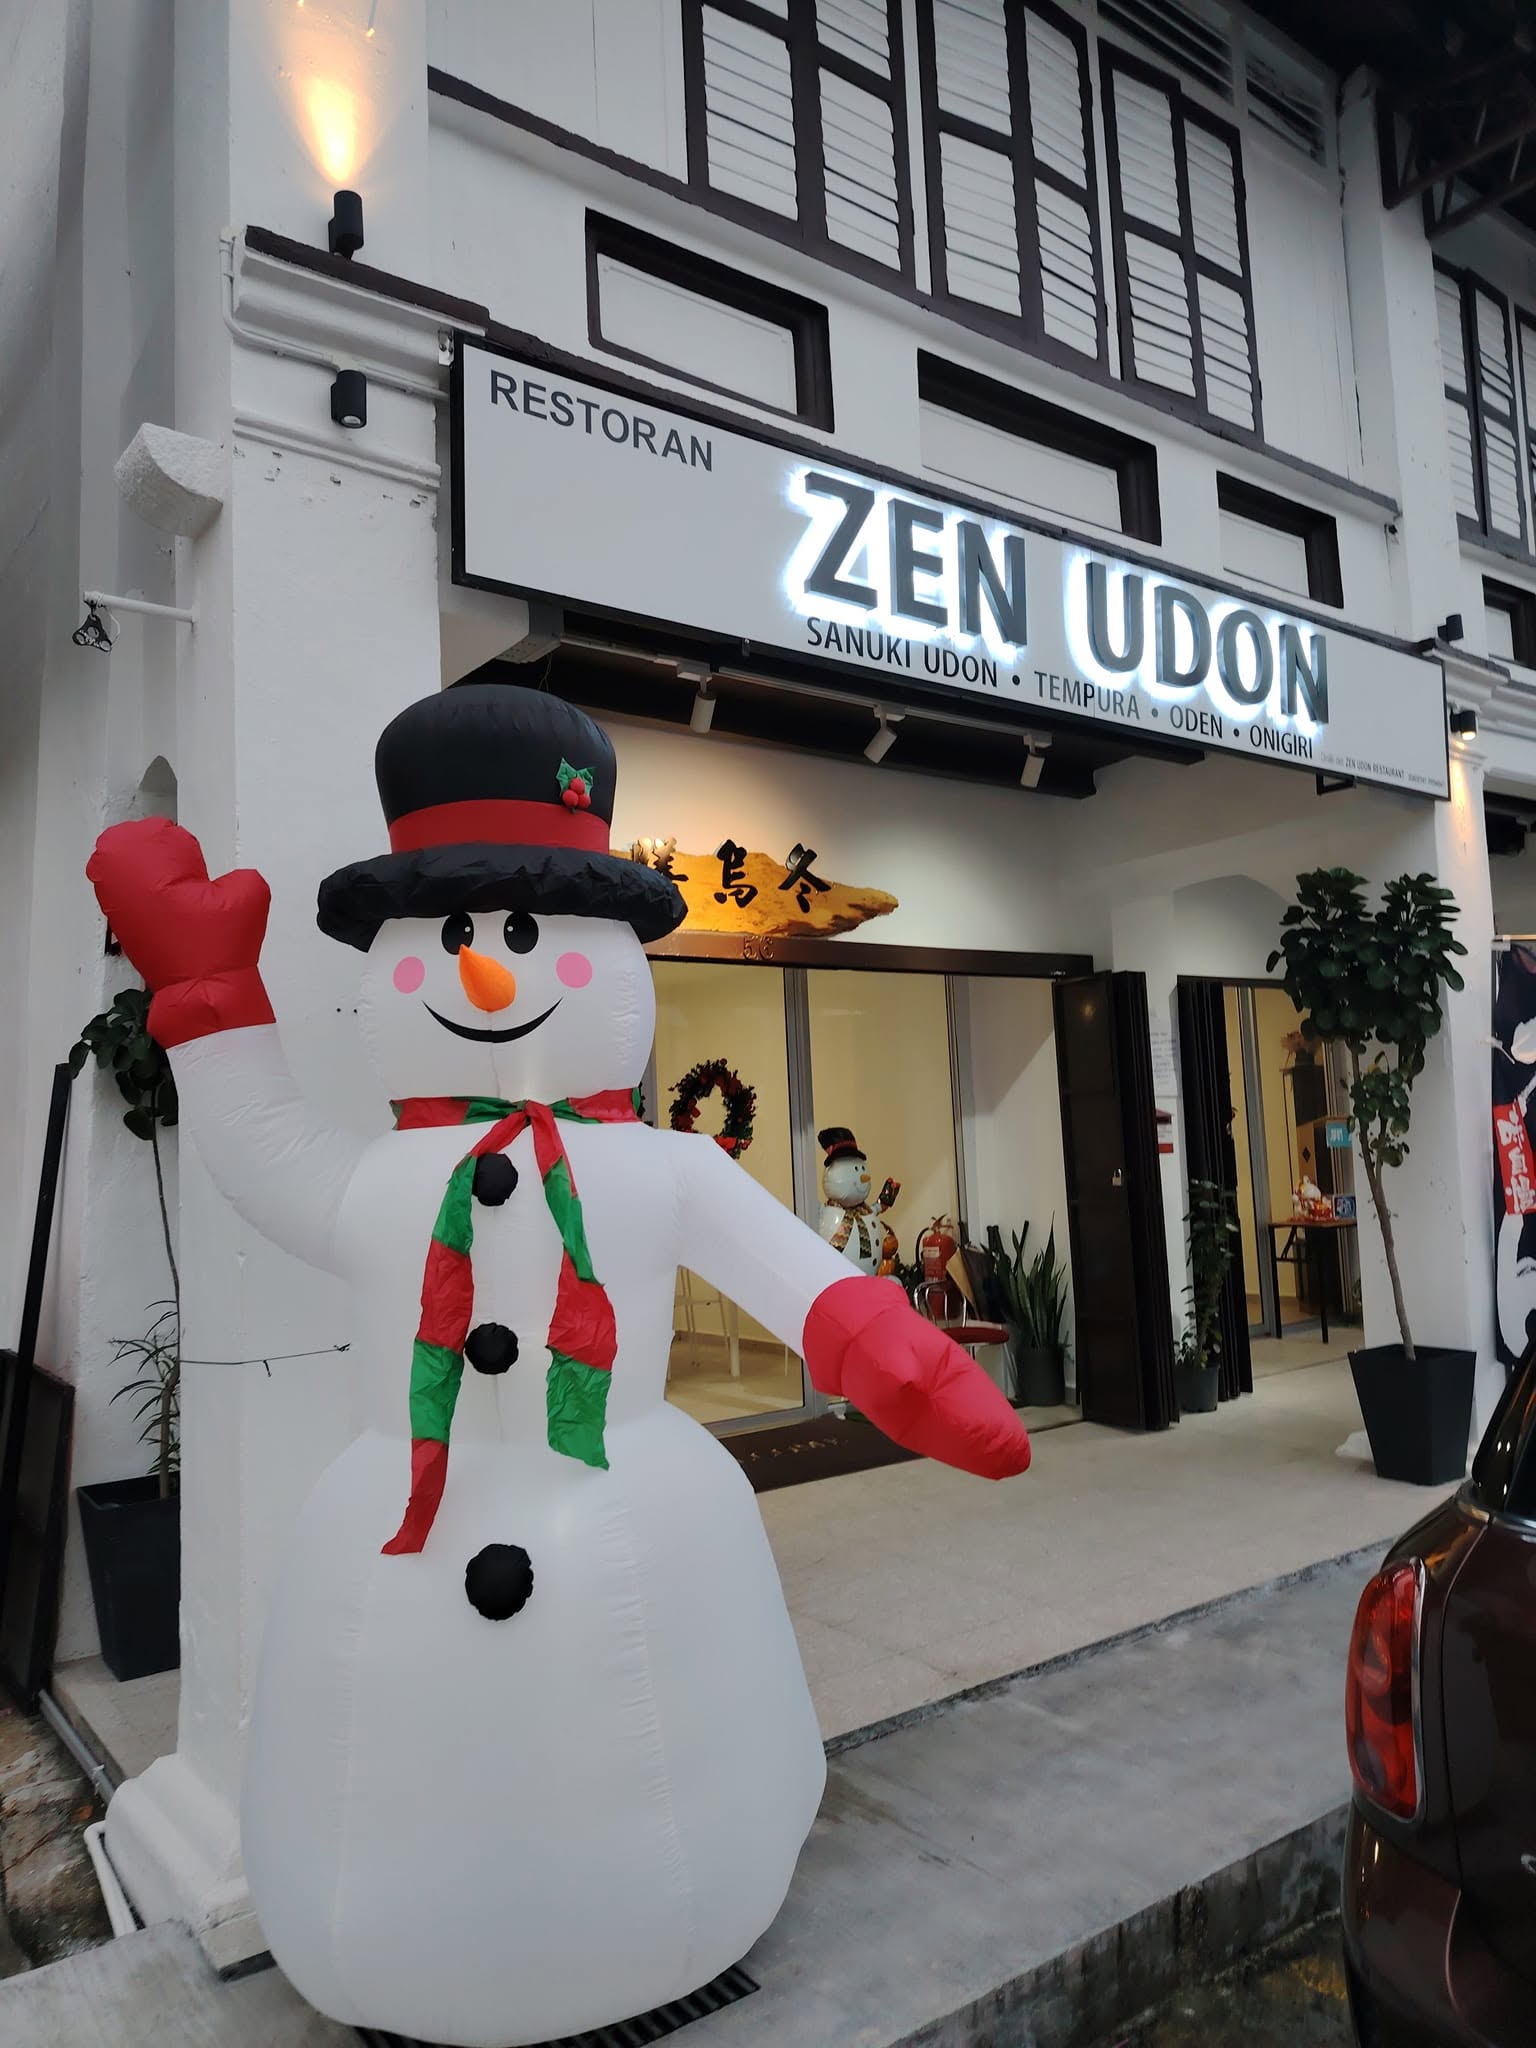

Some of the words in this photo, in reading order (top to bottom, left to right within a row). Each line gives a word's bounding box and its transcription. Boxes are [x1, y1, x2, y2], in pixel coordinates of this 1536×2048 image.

[490, 369, 712, 472] RESTORAN
[804, 471, 1027, 648] ZEN
[1085, 561, 1329, 724] UDON
[807, 616, 911, 668] SANUKI
[924, 644, 998, 688] UDON
[1034, 671, 1140, 720] TEMPURA
[1169, 705, 1223, 739] ODEN
[1249, 725, 1313, 759] ONIGIRI
[1345, 756, 1356, 769] ZEN
